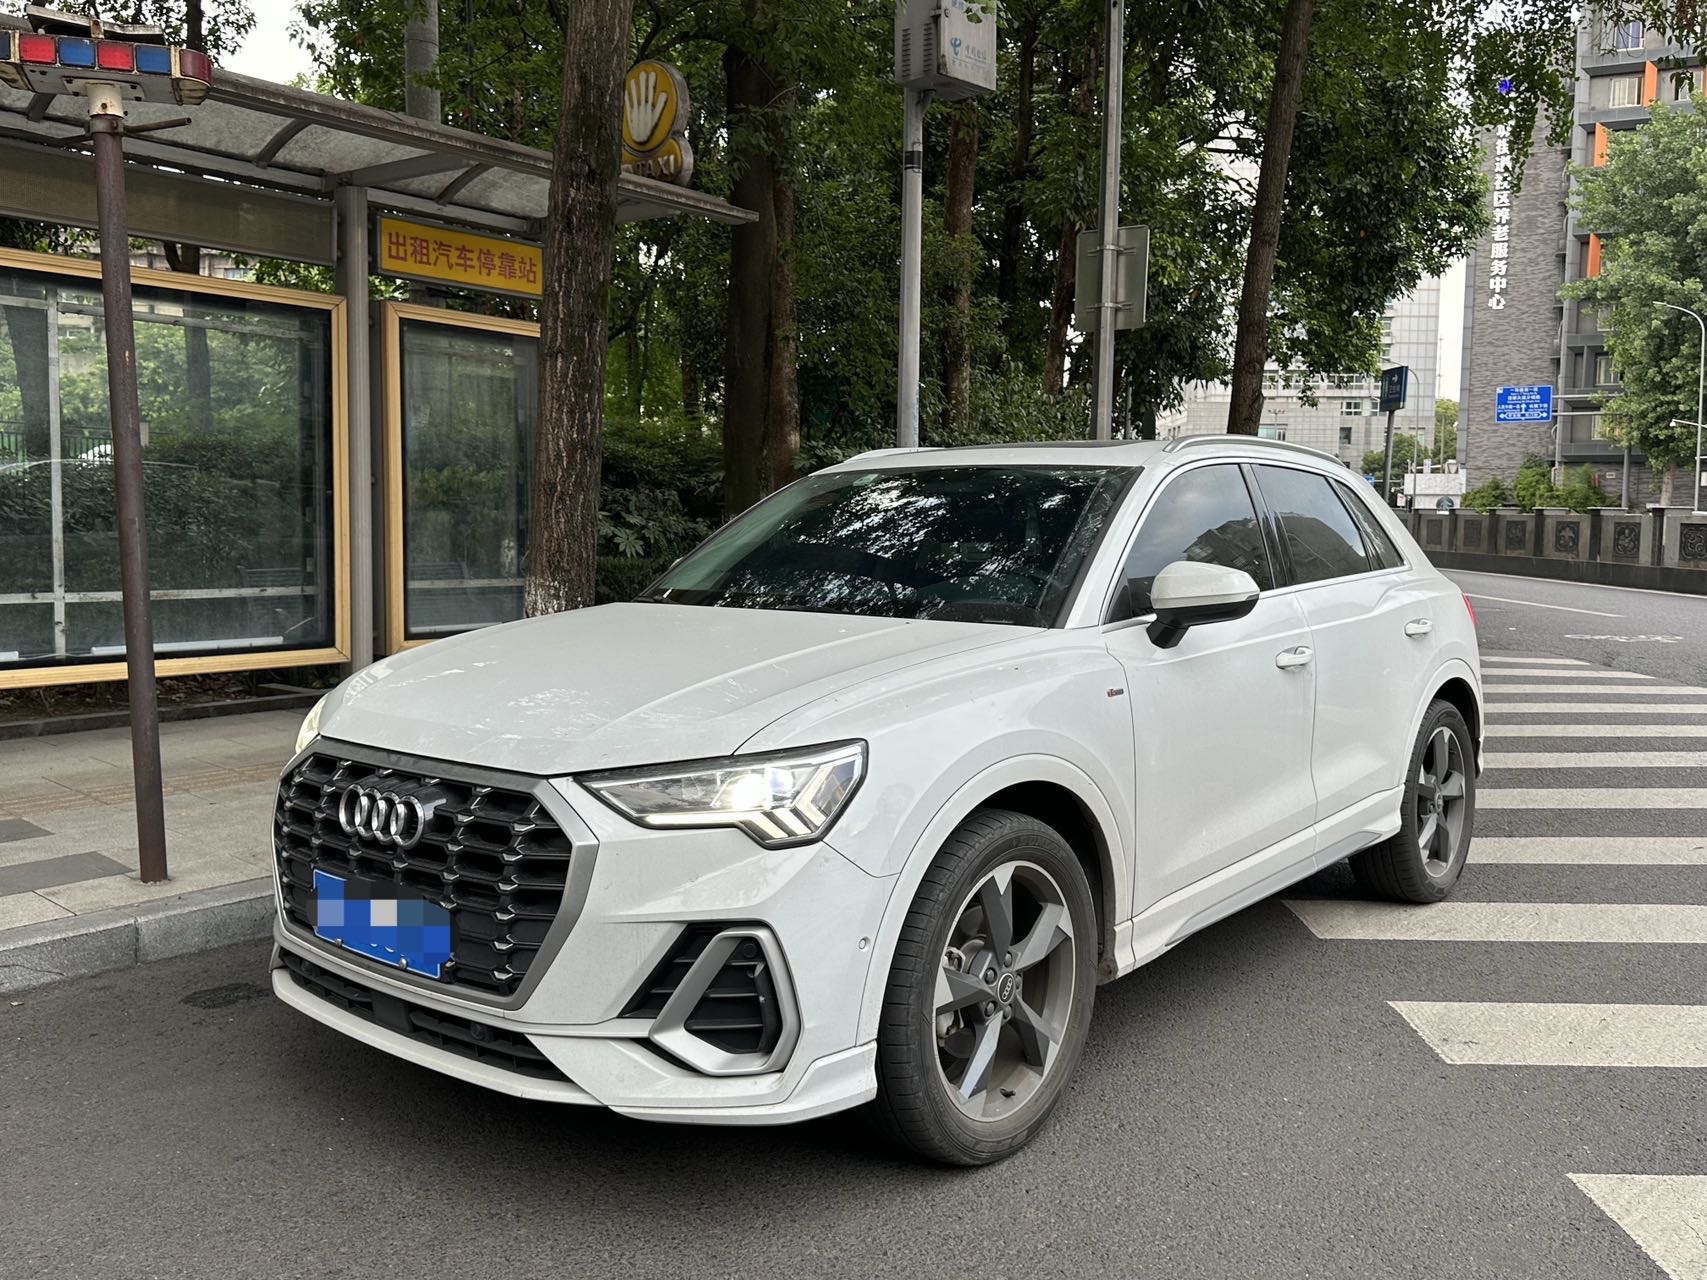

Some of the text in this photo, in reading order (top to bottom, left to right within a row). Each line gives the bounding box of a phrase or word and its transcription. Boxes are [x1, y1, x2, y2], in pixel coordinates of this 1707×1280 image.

[388, 232, 537, 284] 出租汽车停靠站
